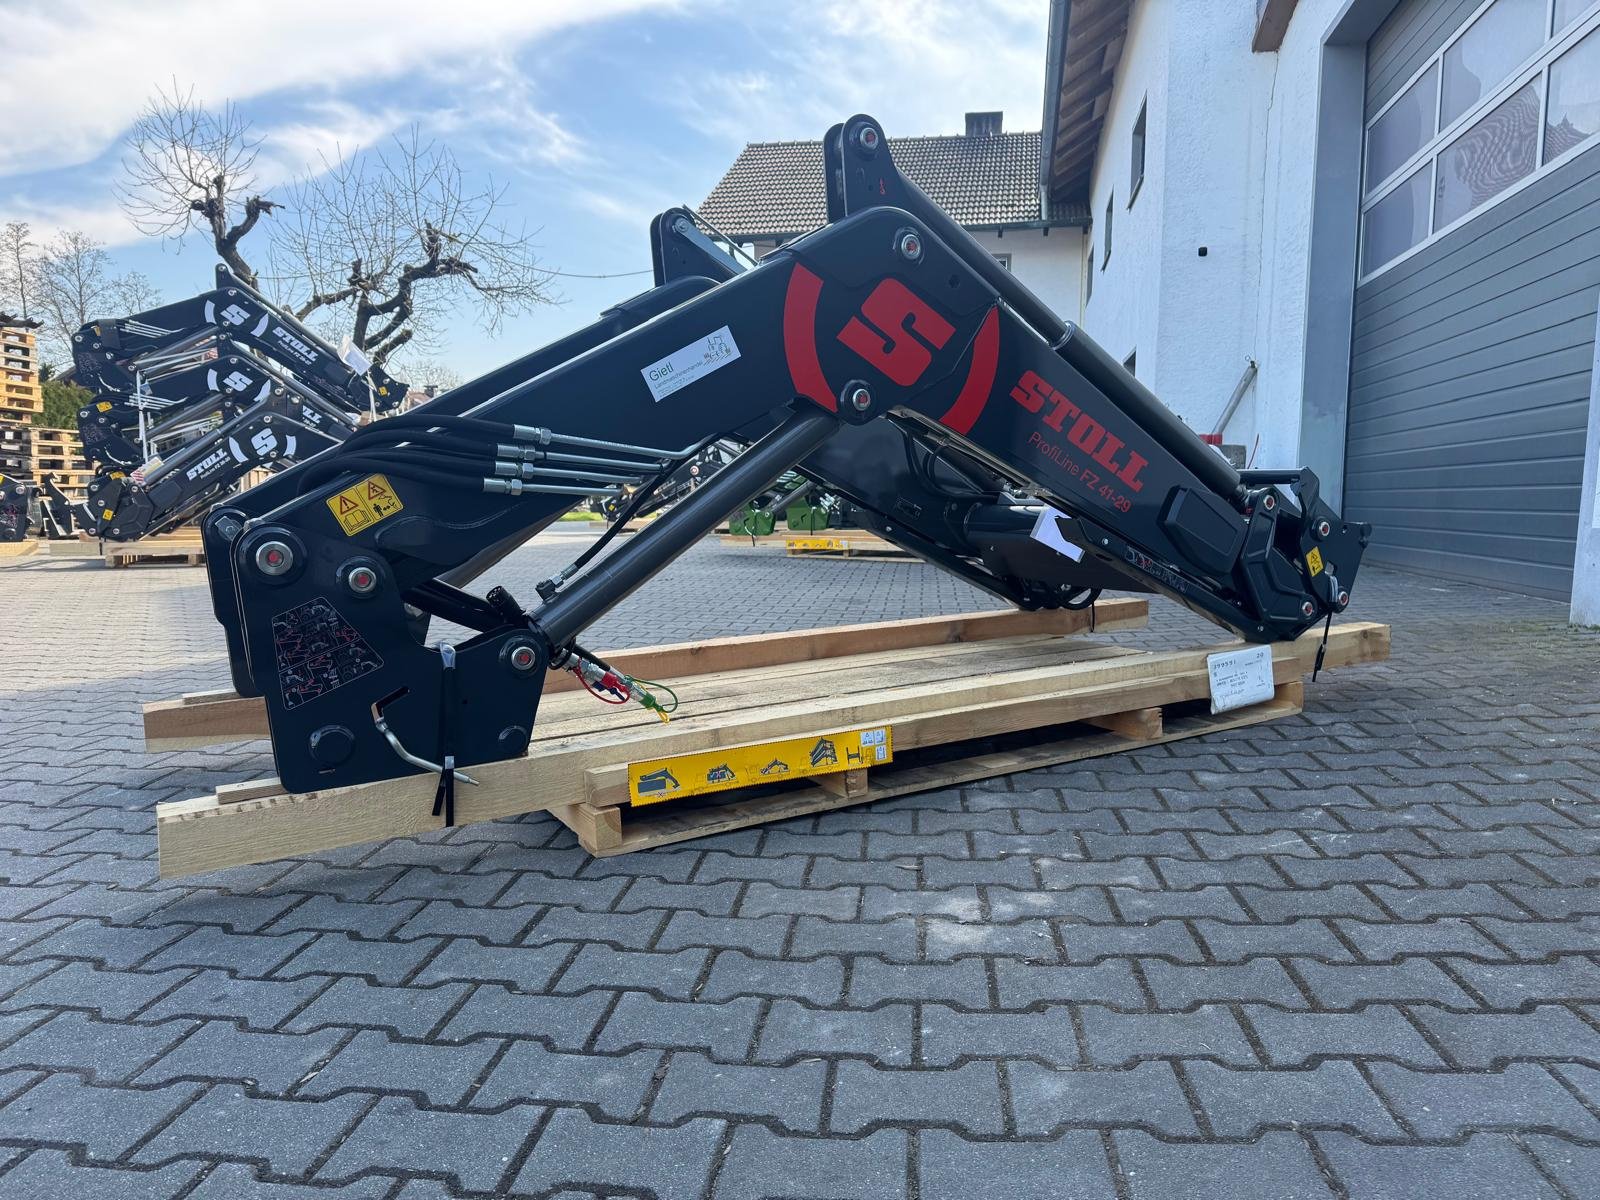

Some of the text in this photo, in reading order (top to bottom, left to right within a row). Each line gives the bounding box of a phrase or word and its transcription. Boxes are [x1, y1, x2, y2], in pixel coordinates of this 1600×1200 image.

[272, 326, 319, 362] STOLL
[649, 362, 674, 381] Gietl
[1009, 369, 1149, 493] STOLL
[186, 448, 228, 480] STOLL
[1027, 431, 1132, 513] ProfiLine FZ 41-29
